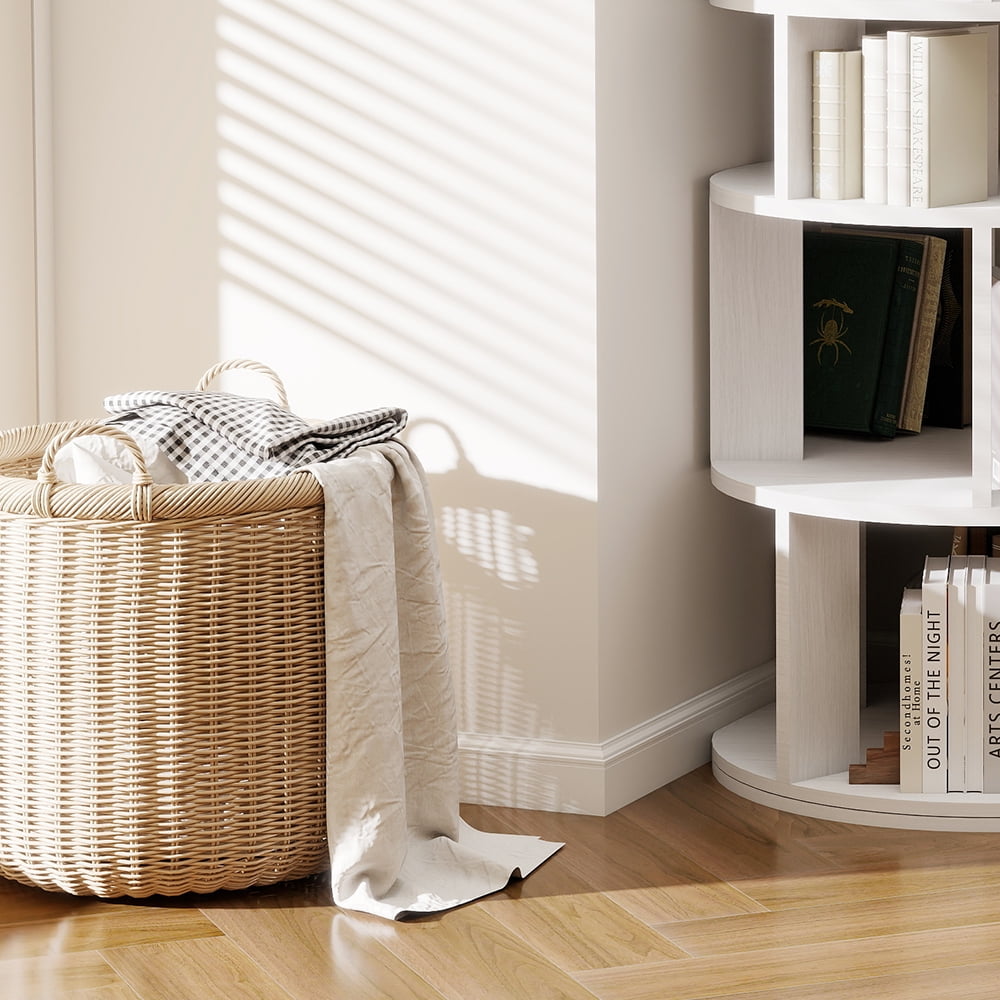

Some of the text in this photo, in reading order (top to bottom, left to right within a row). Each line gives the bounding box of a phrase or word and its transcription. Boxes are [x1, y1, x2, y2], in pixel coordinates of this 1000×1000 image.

[912, 41, 923, 203] WILLIAM SHAKESPEARE
[902, 653, 912, 750] Secondhomes!
[912, 680, 921, 726] at Home
[927, 610, 941, 770] OUT OF THE NIGHT
